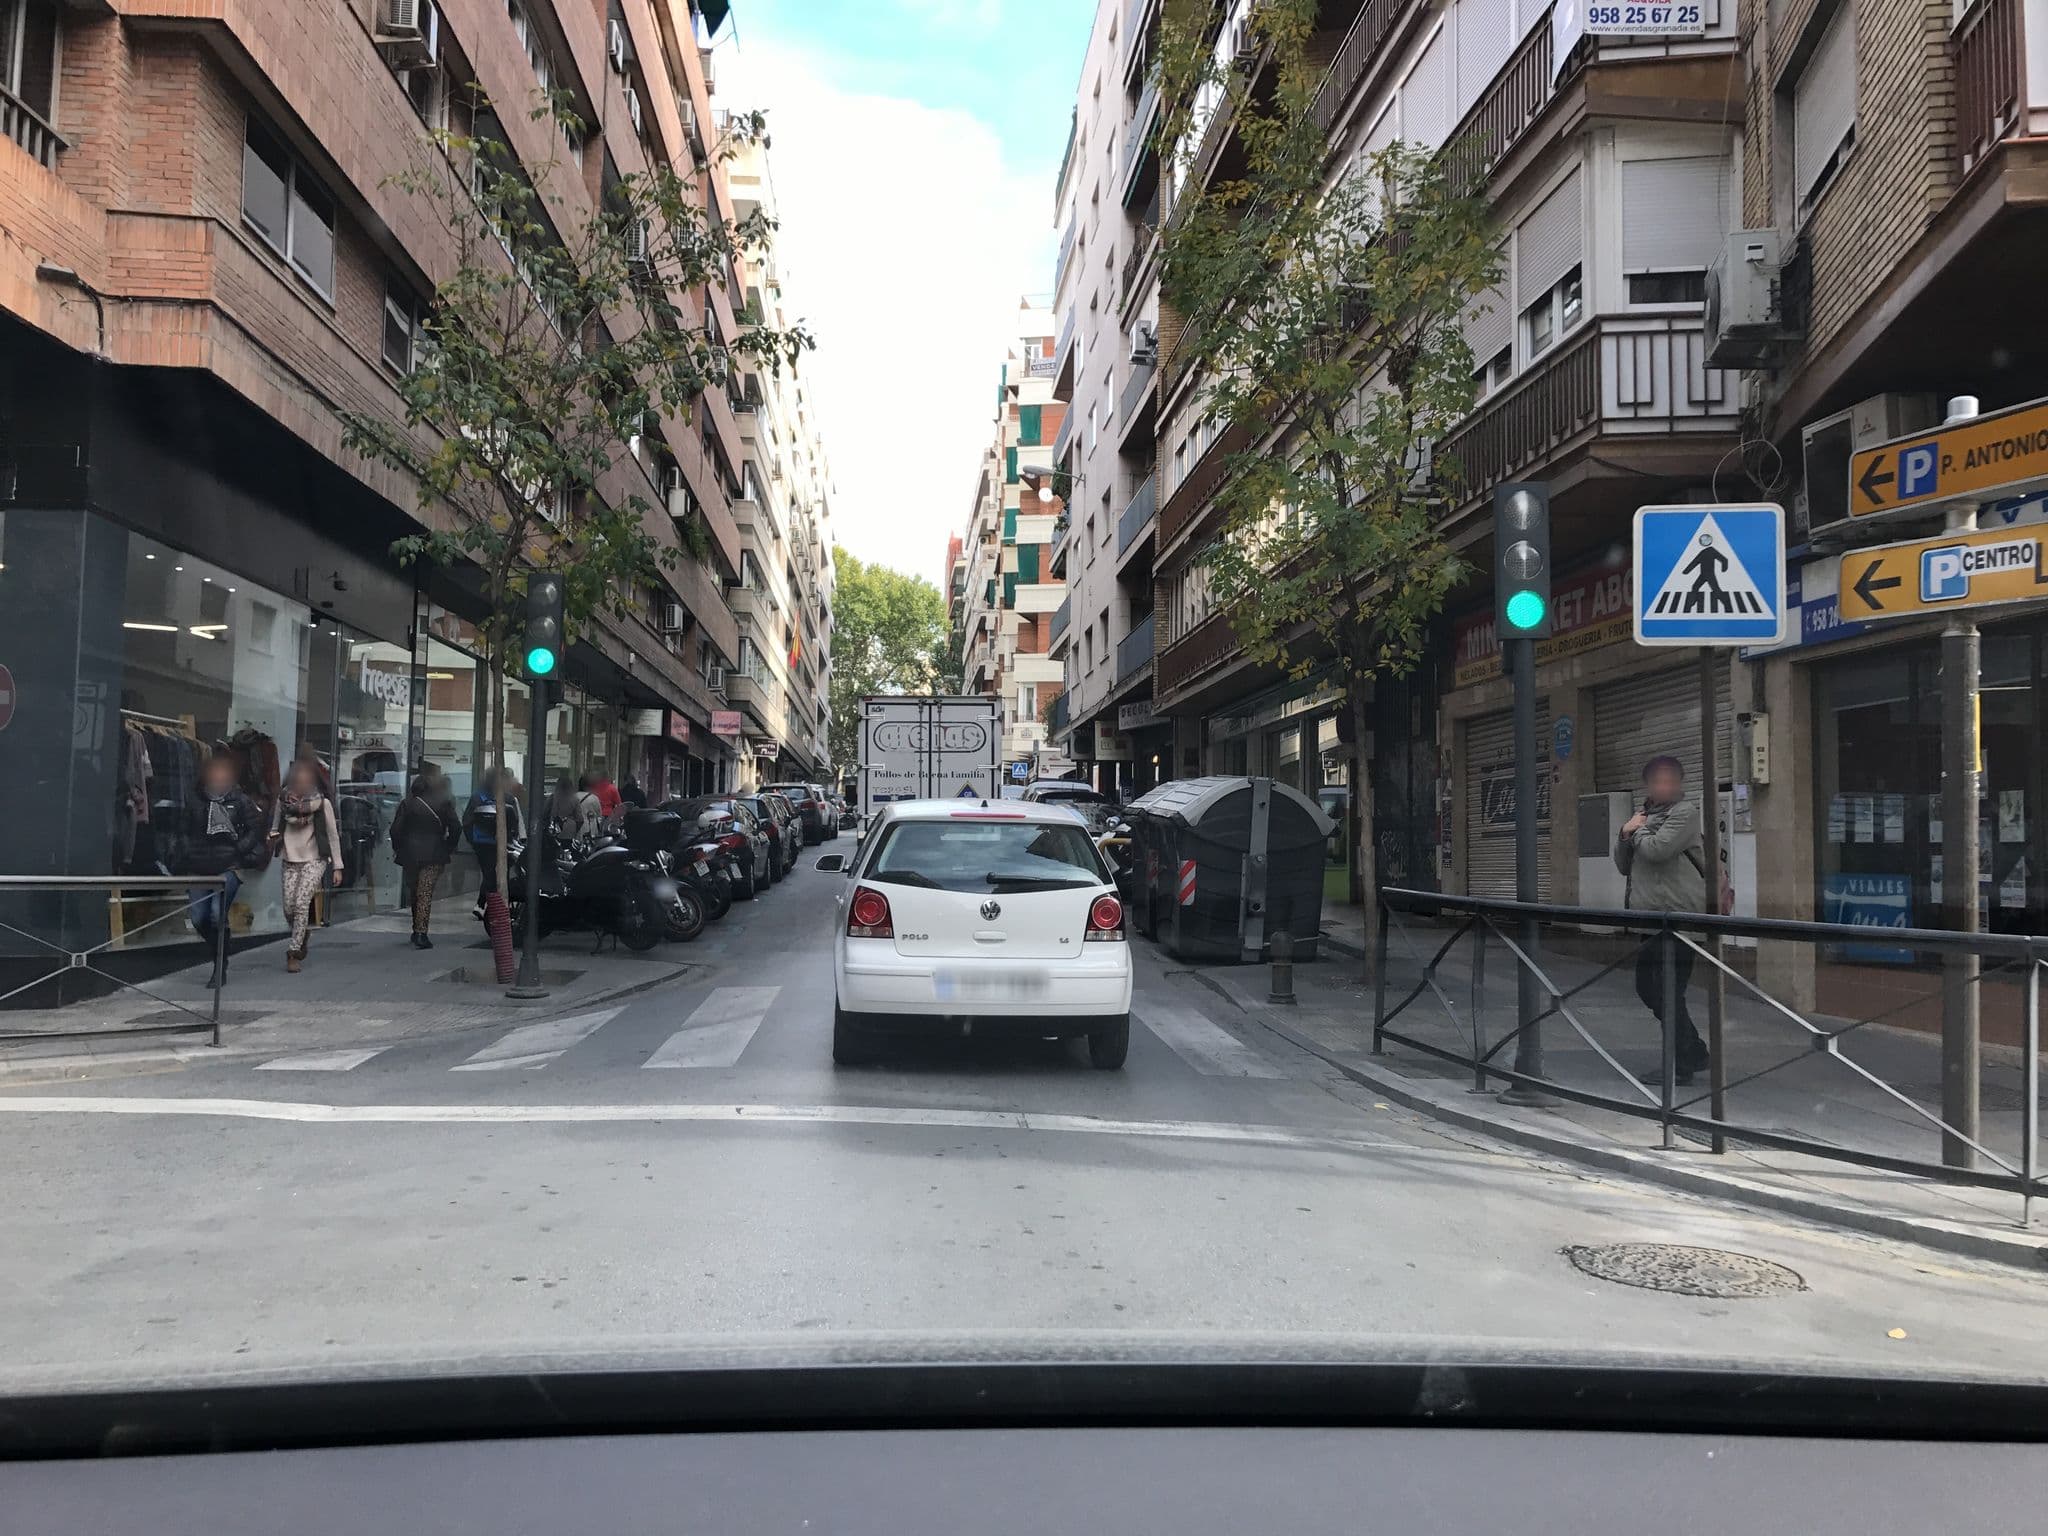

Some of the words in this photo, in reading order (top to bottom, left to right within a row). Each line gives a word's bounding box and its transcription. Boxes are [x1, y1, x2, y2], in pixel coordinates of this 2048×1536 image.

[1589, 7, 1620, 24] 958
[1625, 7, 1647, 24] 25
[1651, 7, 1672, 24] 67
[1678, 6, 1699, 23] 25
[1905, 449, 1933, 494] P
[1941, 456, 1957, 475] P.
[1964, 428, 2048, 471] ANTONIO
[1930, 553, 1959, 596] P
[1963, 542, 2033, 572] CENTRO
[874, 770, 901, 779] Pollos
[904, 770, 916, 779] de
[1849, 879, 1904, 894] VIAJES
[901, 933, 929, 941] POLO
